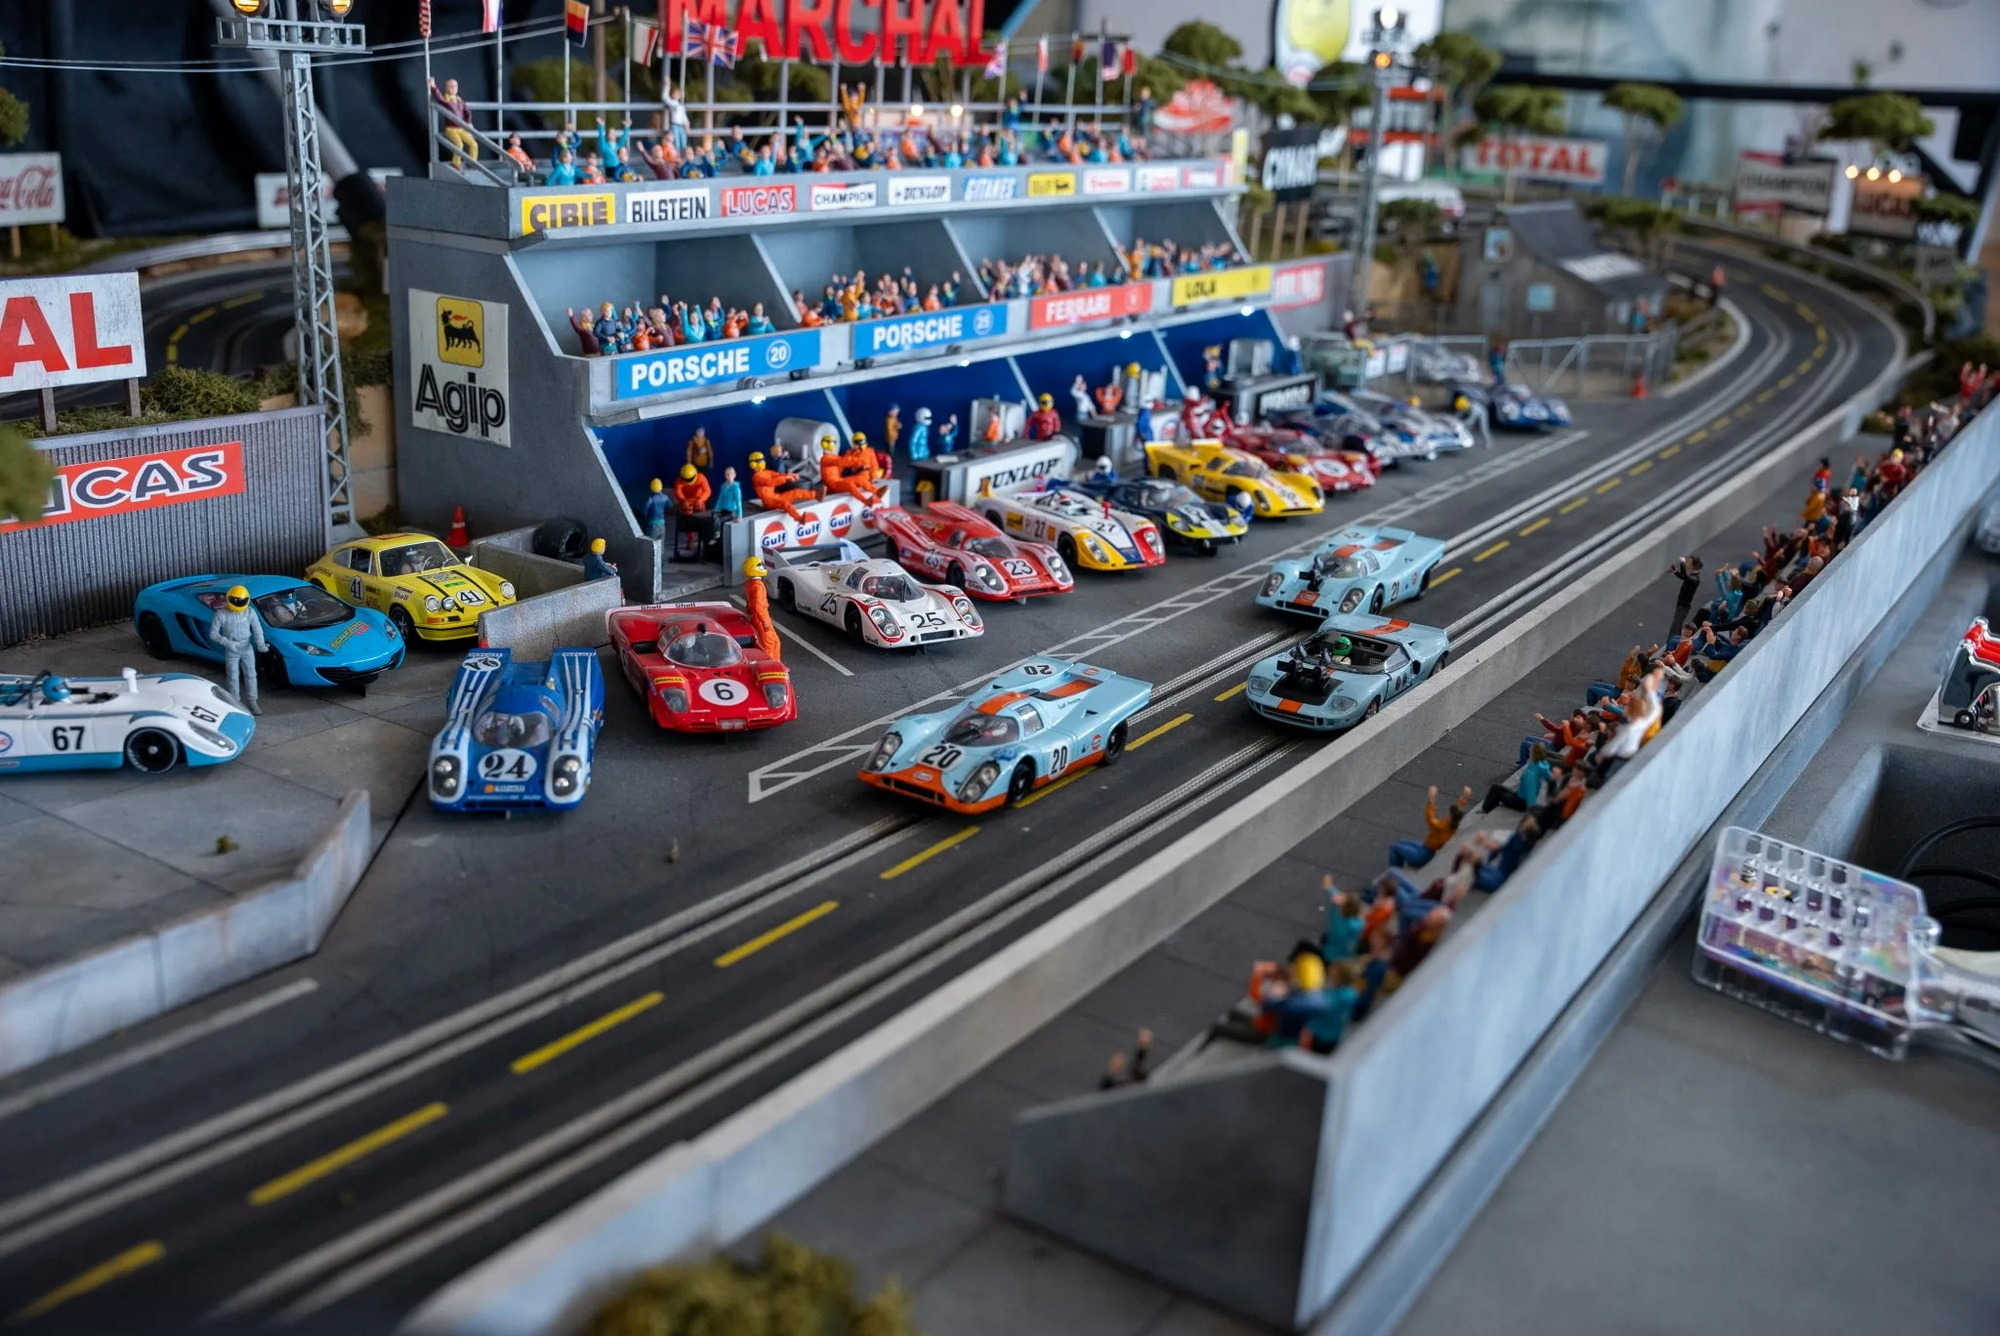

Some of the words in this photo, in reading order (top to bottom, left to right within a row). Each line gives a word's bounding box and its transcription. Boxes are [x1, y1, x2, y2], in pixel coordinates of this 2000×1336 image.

[665, 0, 994, 66] MARCHAL
[1478, 139, 1600, 179] TOTAL
[631, 195, 708, 223] BILSTEIN
[727, 186, 794, 216] LUCAS
[814, 191, 875, 207] CHAMPION
[1185, 278, 1217, 300] LOLA
[1045, 292, 1112, 324] FERRARI
[872, 315, 964, 351] PORSCHE
[630, 346, 751, 391] PORSCHE
[769, 343, 788, 365] 20
[415, 363, 507, 437] Agip
[796, 523, 820, 537] Gulf
[830, 514, 853, 528] Gulf
[761, 532, 787, 547] Gulf
[1003, 559, 1034, 577] 23
[350, 577, 363, 600] 41
[460, 589, 482, 604] 41
[820, 592, 841, 616] 25
[910, 611, 946, 629] 25
[713, 682, 735, 701] 6
[52, 726, 86, 752] 67
[485, 754, 529, 779] 24
[922, 745, 963, 770] 20
[1051, 746, 1068, 775] 20
